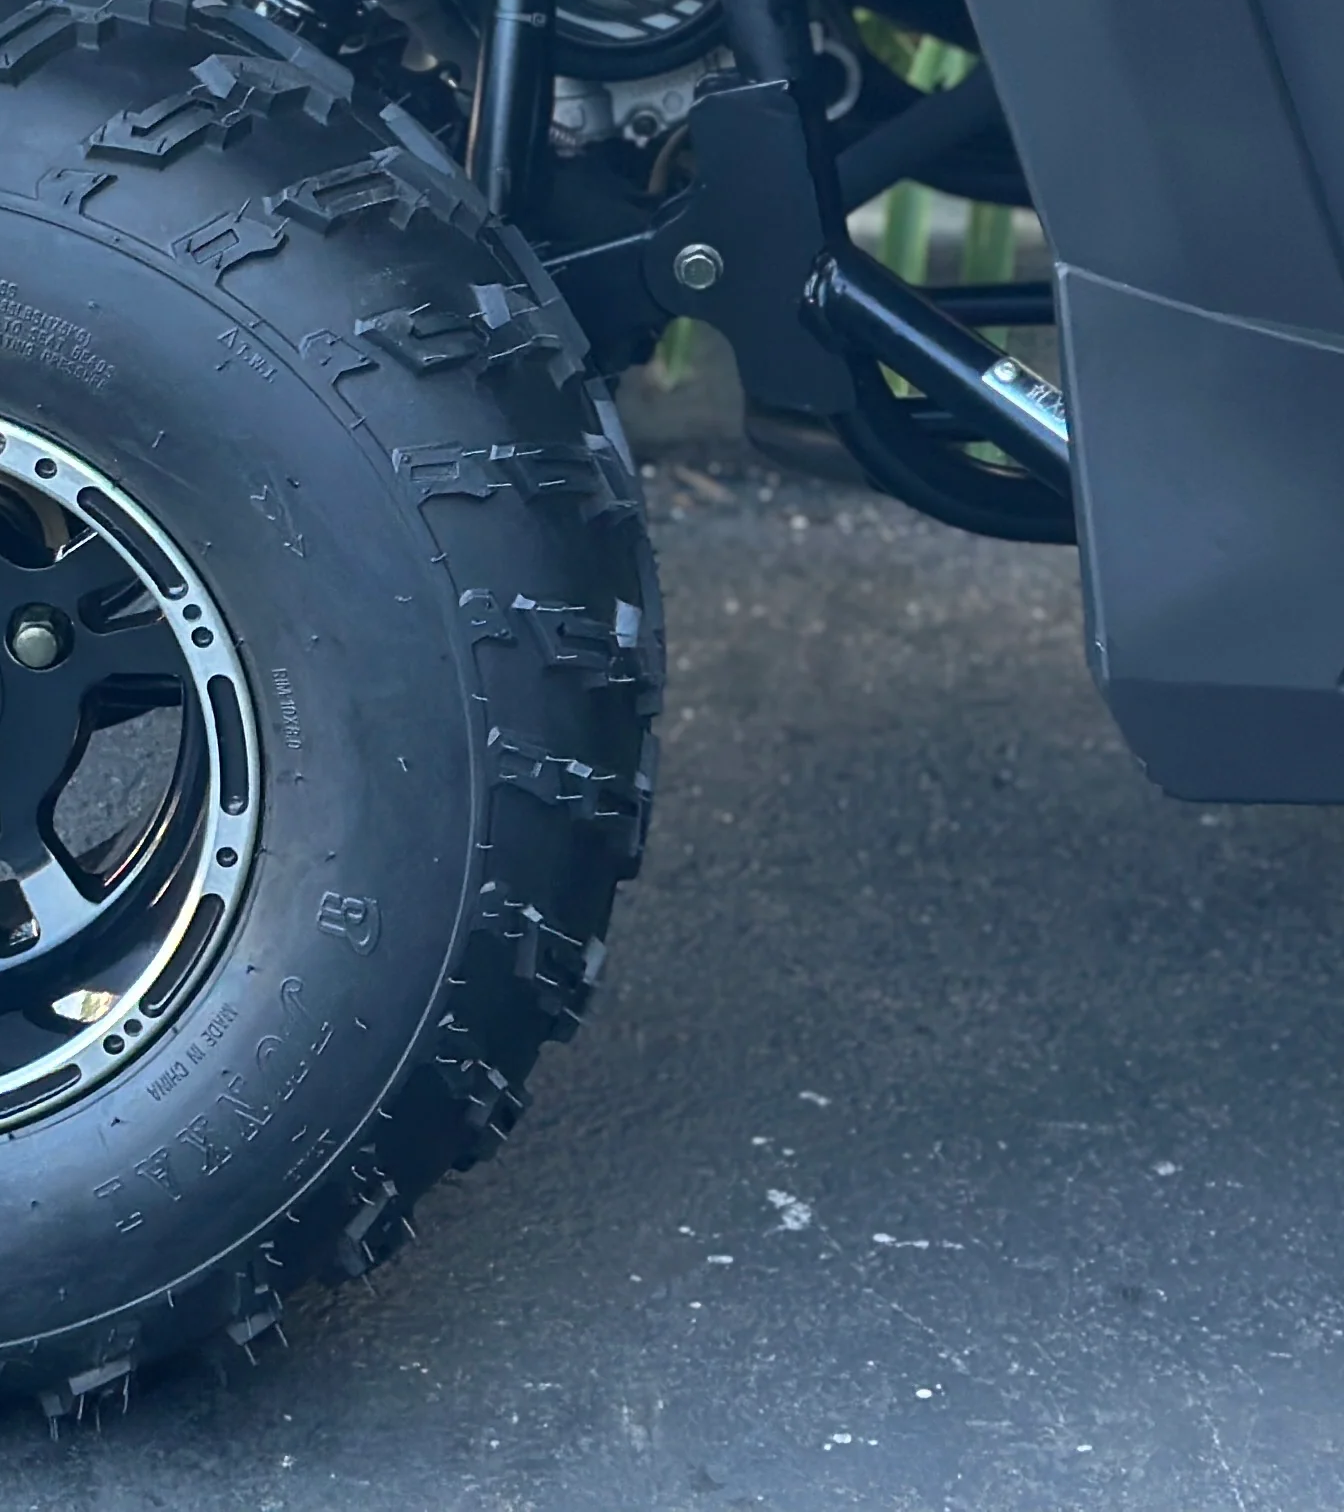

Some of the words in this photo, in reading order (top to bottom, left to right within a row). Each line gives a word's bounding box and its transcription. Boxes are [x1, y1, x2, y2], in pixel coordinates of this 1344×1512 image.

[3, 315, 23, 334] TO
[200, 1002, 239, 1047] MADE
[185, 1042, 206, 1065] IN
[146, 1061, 190, 1102] CHINA
